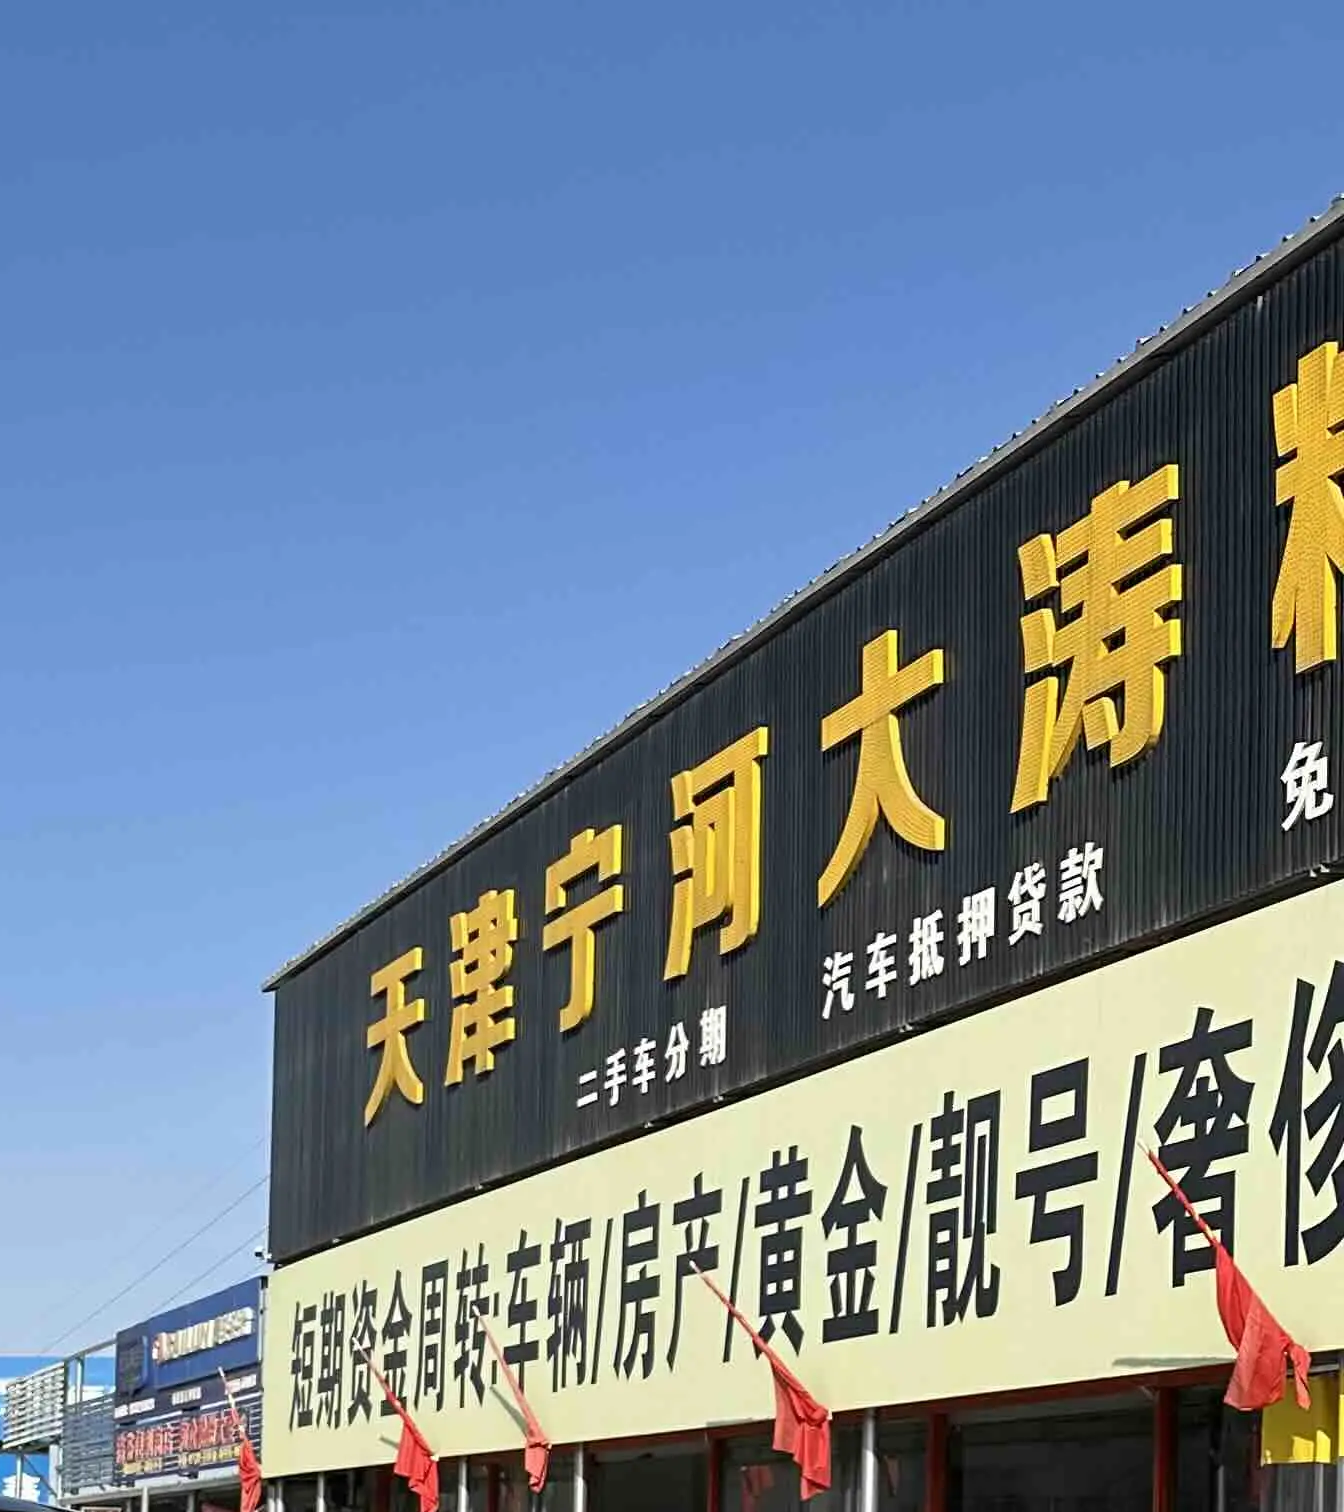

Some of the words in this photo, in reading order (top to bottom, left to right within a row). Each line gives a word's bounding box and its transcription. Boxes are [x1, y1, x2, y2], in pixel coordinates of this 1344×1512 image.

[576, 1004, 727, 1108] 二手车分期
[822, 841, 1105, 1020] 汽车抵押贷款
[1280, 740, 1335, 831] 免
